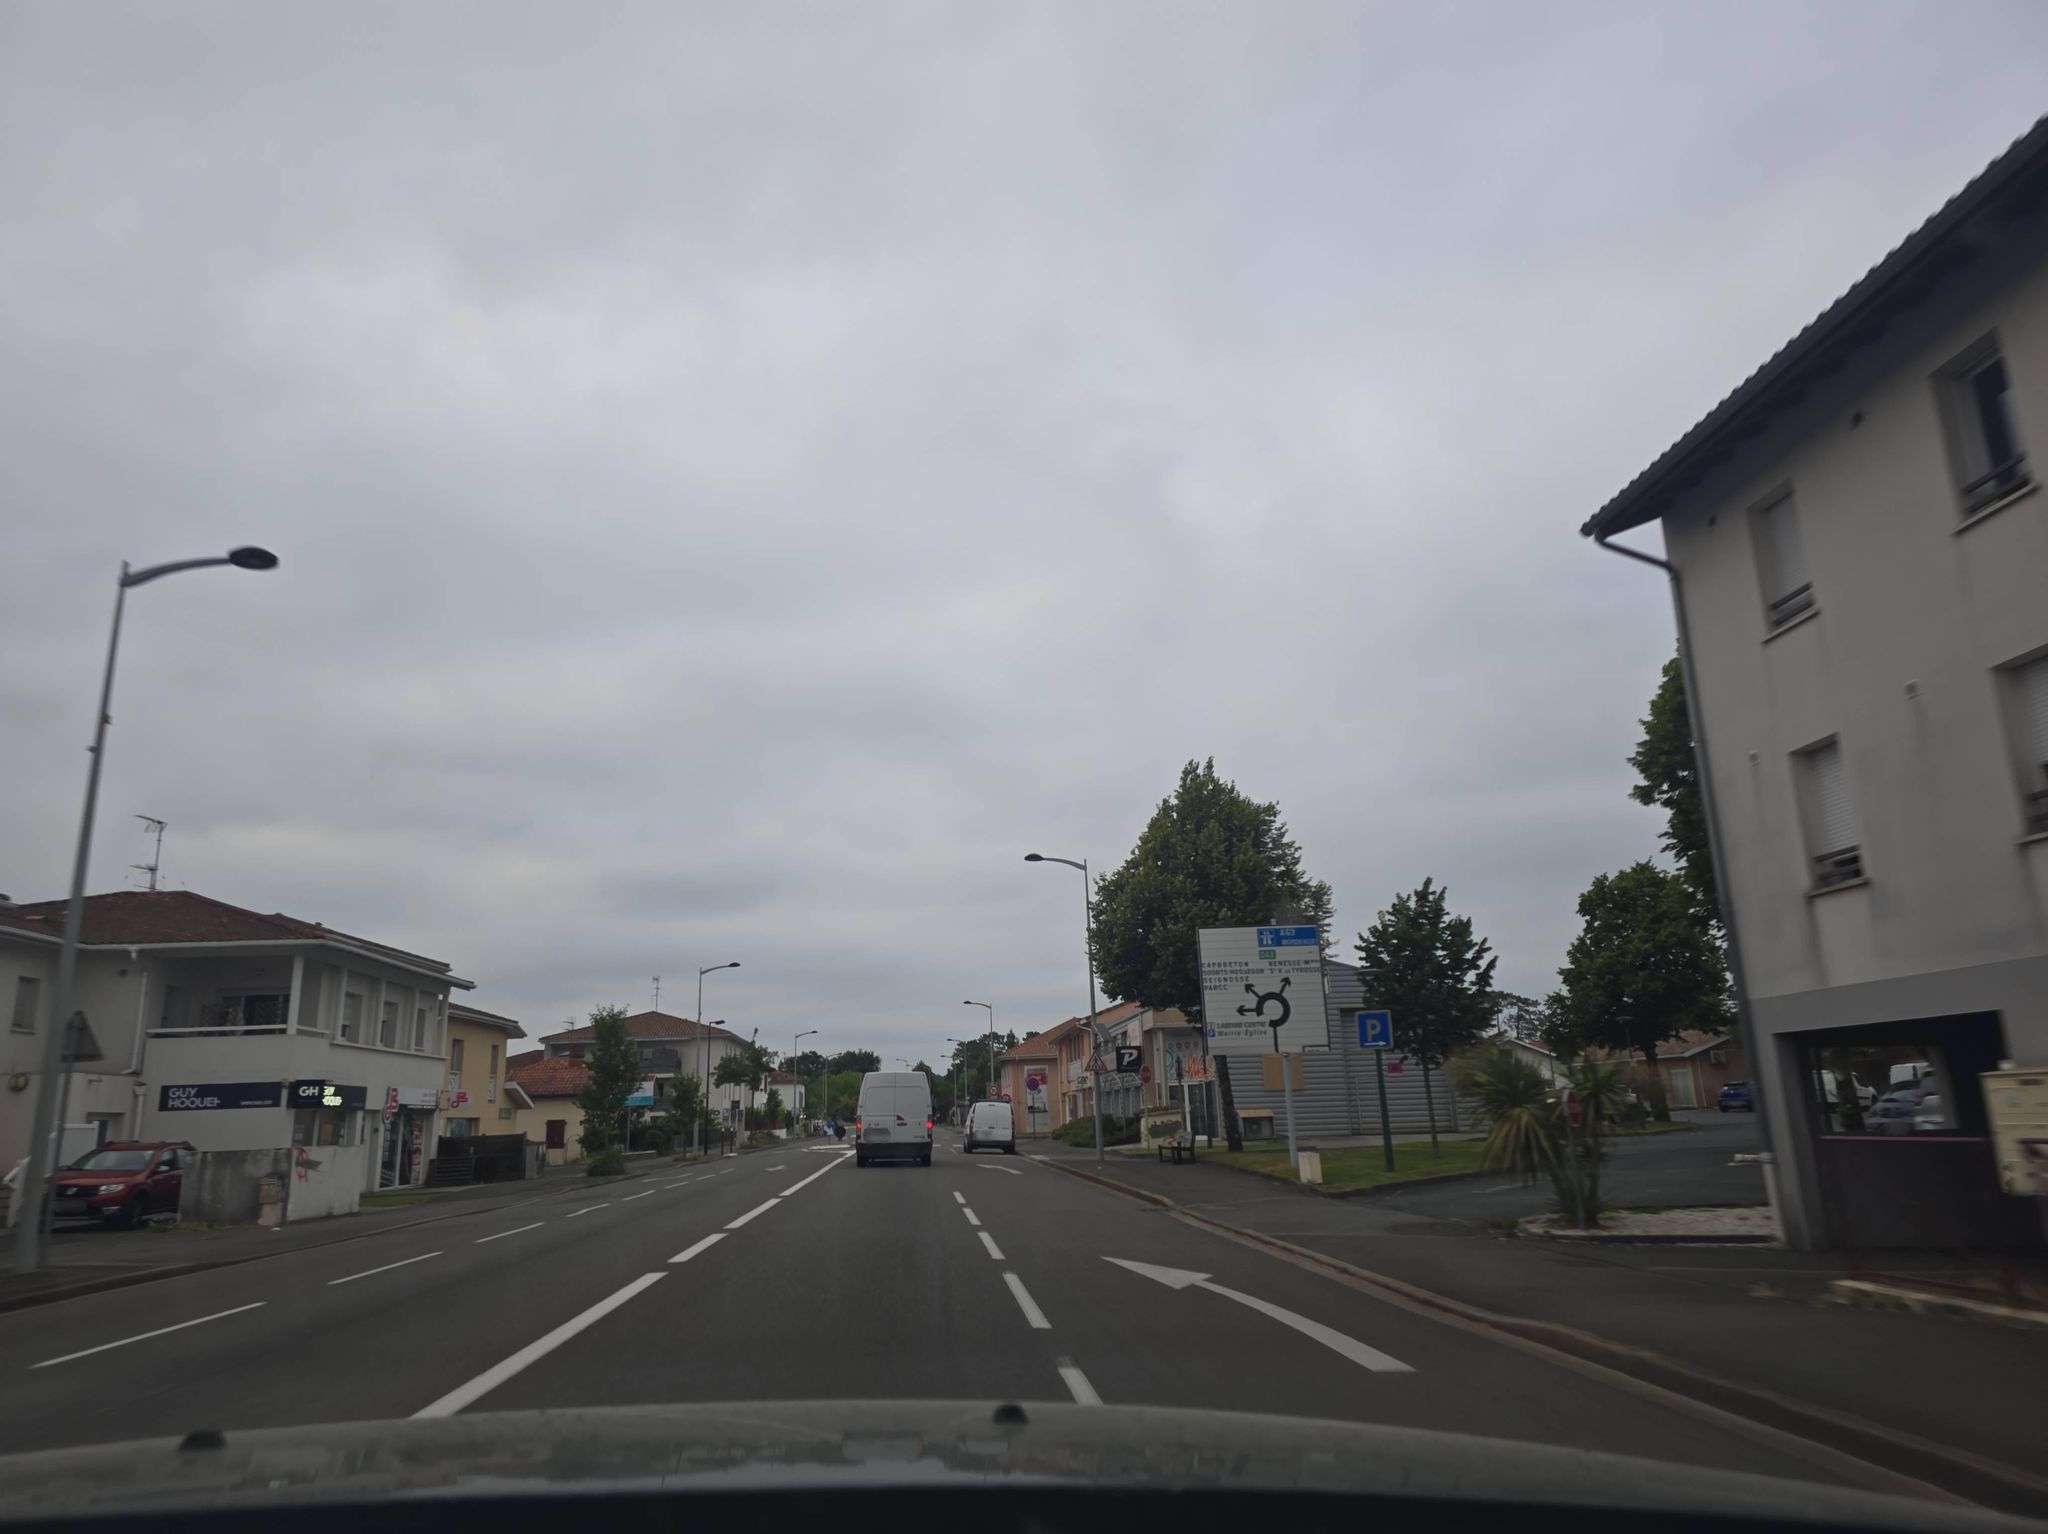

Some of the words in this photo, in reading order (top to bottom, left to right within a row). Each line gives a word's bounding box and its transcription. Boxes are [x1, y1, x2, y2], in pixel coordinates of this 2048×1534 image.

[1365, 1019, 1381, 1042] P
[168, 1087, 198, 1098] GUY
[299, 1085, 319, 1096] GH
